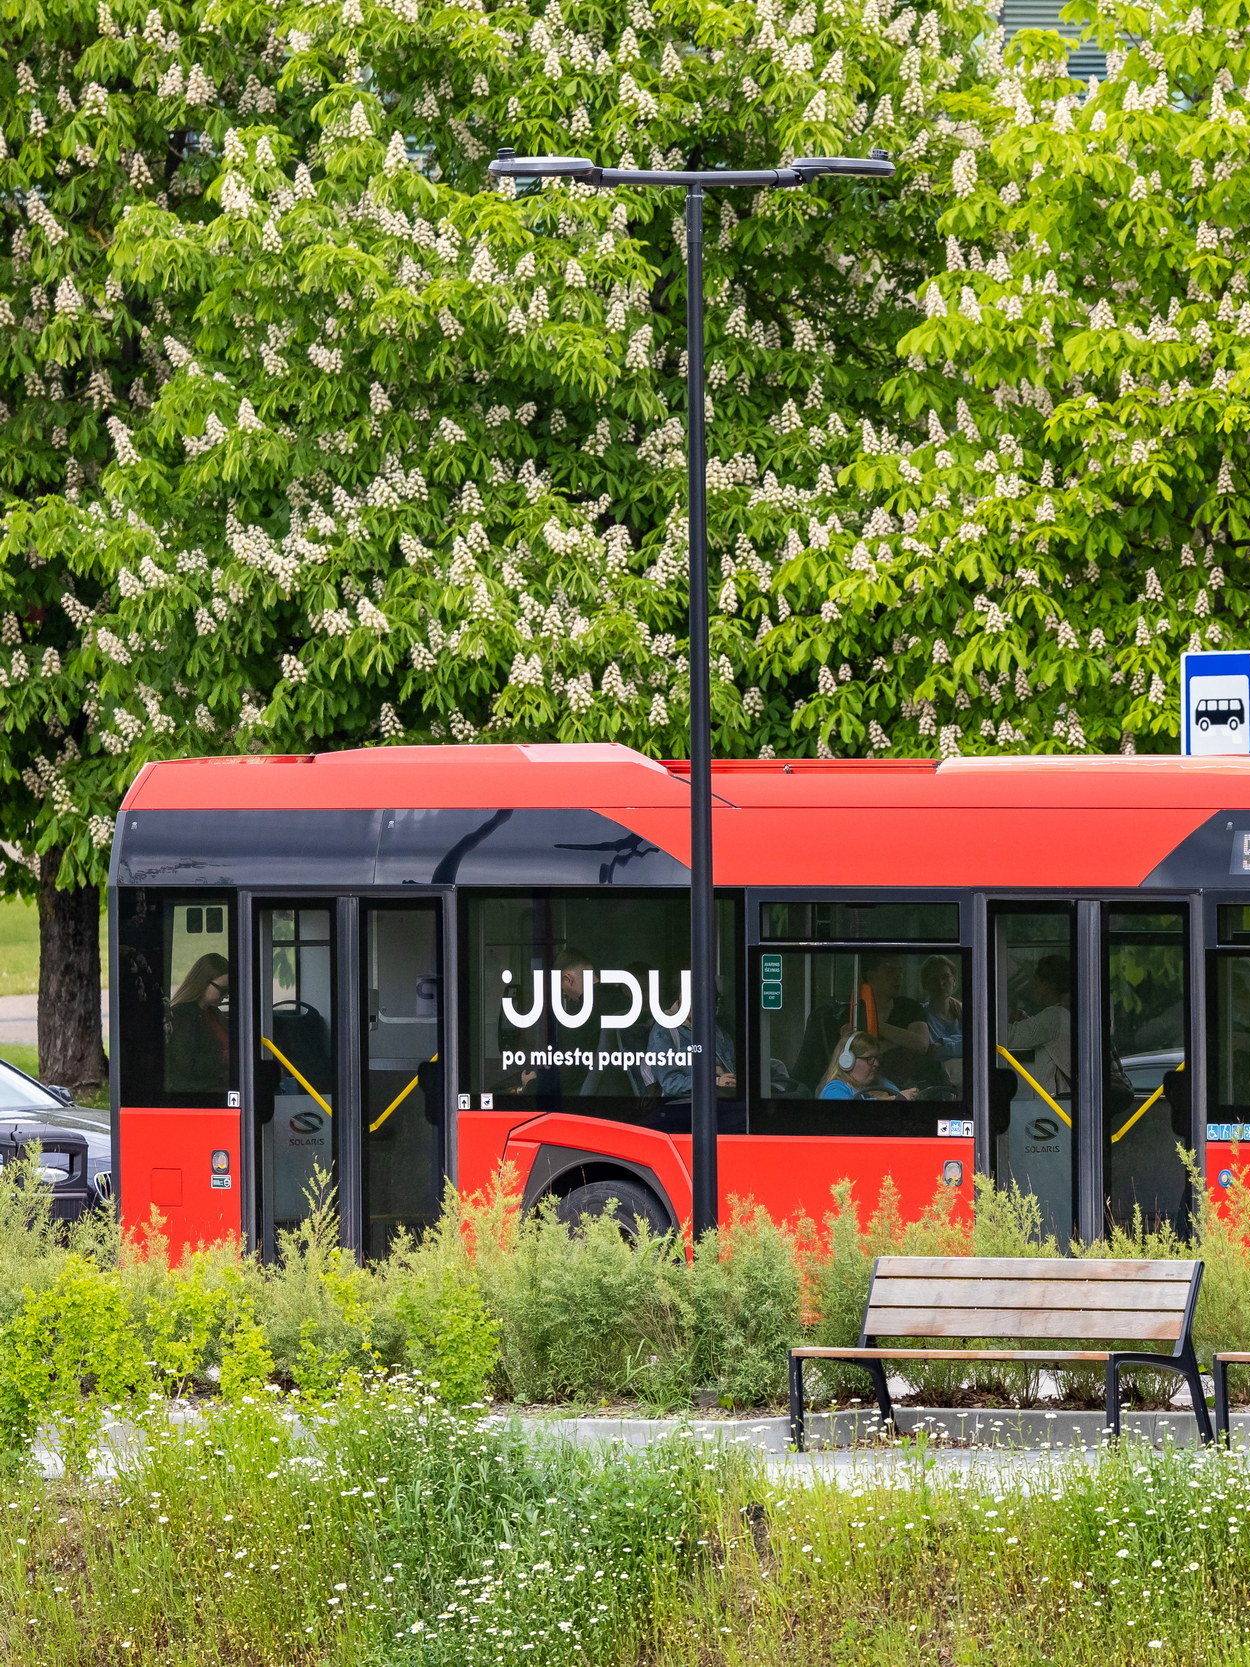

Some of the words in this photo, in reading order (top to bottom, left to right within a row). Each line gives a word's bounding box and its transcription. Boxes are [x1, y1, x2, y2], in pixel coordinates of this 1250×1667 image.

[502, 1050, 526, 1070] po
[530, 1045, 594, 1071] miestą
[598, 1045, 692, 1071] paprastai
[289, 1138, 325, 1146] SOLARIS
